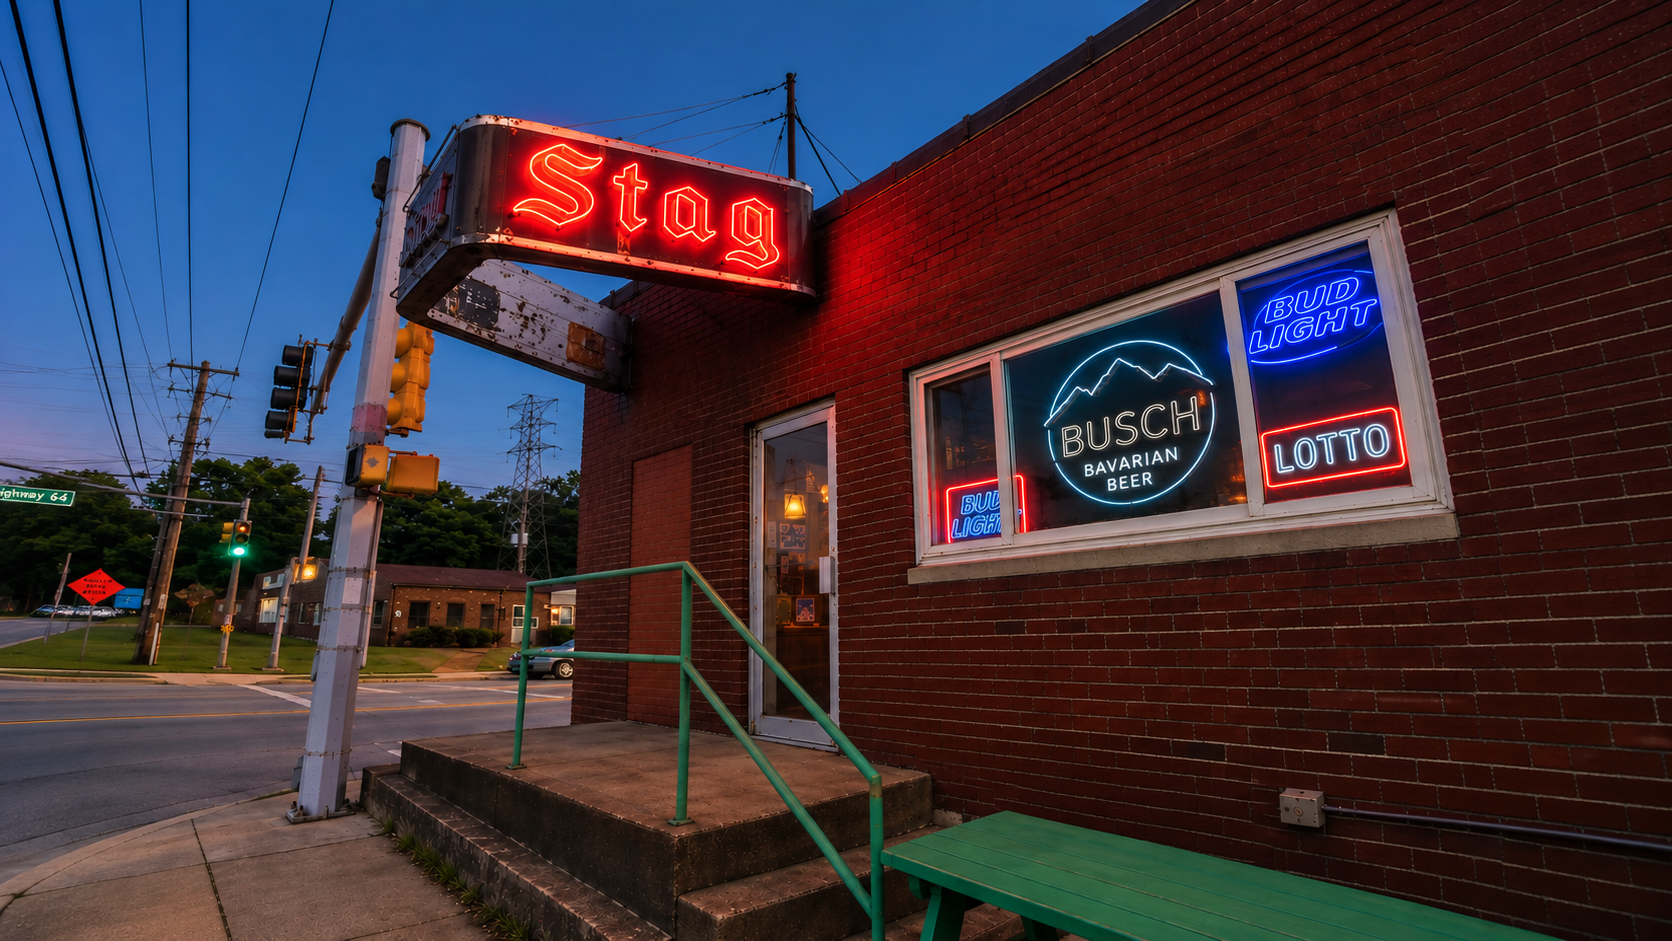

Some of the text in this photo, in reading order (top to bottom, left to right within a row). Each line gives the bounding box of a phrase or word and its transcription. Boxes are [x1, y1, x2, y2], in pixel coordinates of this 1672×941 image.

[513, 143, 780, 270] Stag
[1264, 276, 1360, 324] BUD
[1248, 298, 1378, 355] LIGHT
[1061, 395, 1200, 458] BUSCH
[1273, 423, 1391, 474] LOTTO
[1083, 446, 1179, 478] BAVARIAN
[1106, 471, 1154, 492] BEER
[0, 487, 45, 502] ighway
[951, 512, 1003, 539] LIGH
